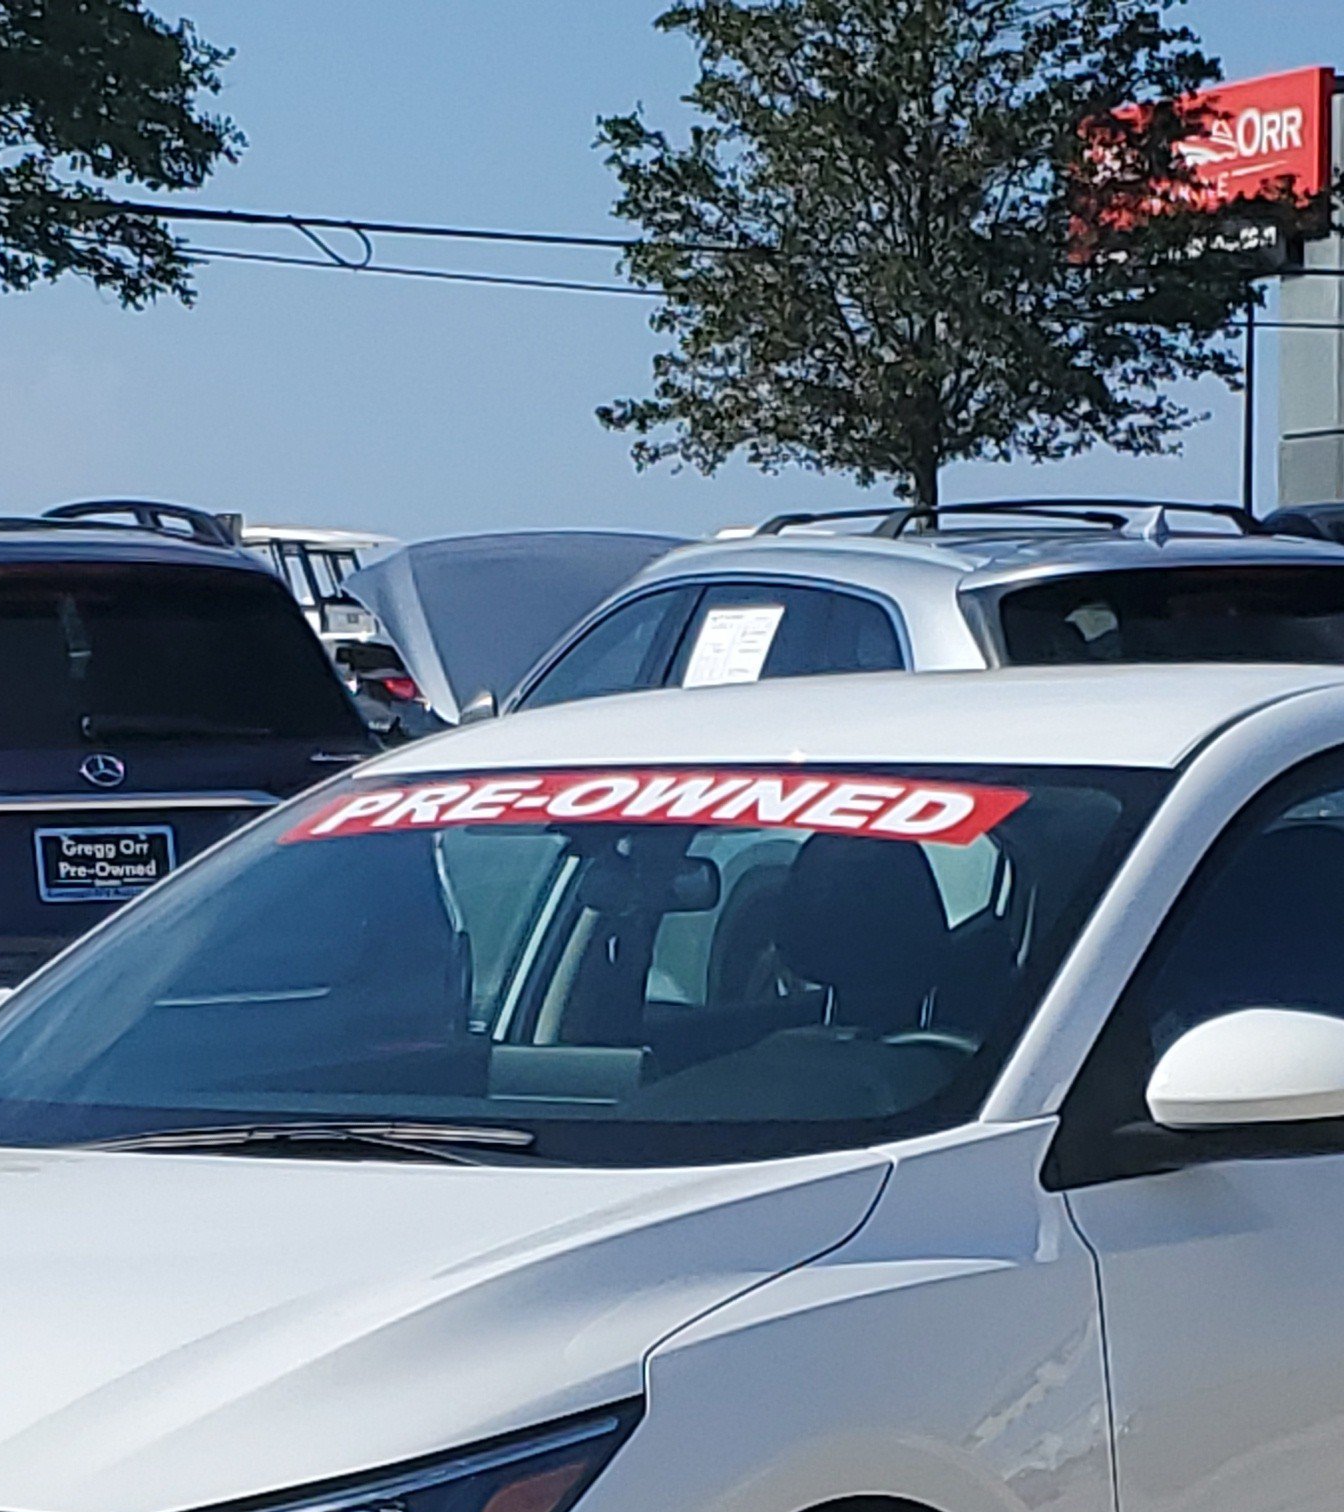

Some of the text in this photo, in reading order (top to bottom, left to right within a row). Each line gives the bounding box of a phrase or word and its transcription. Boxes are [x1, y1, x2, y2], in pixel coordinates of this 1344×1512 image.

[1236, 106, 1303, 158] ORR
[310, 776, 976, 836] PRE-OWNED
[61, 839, 150, 859] Gregg Orr
[58, 859, 157, 878] Pre-Owned
